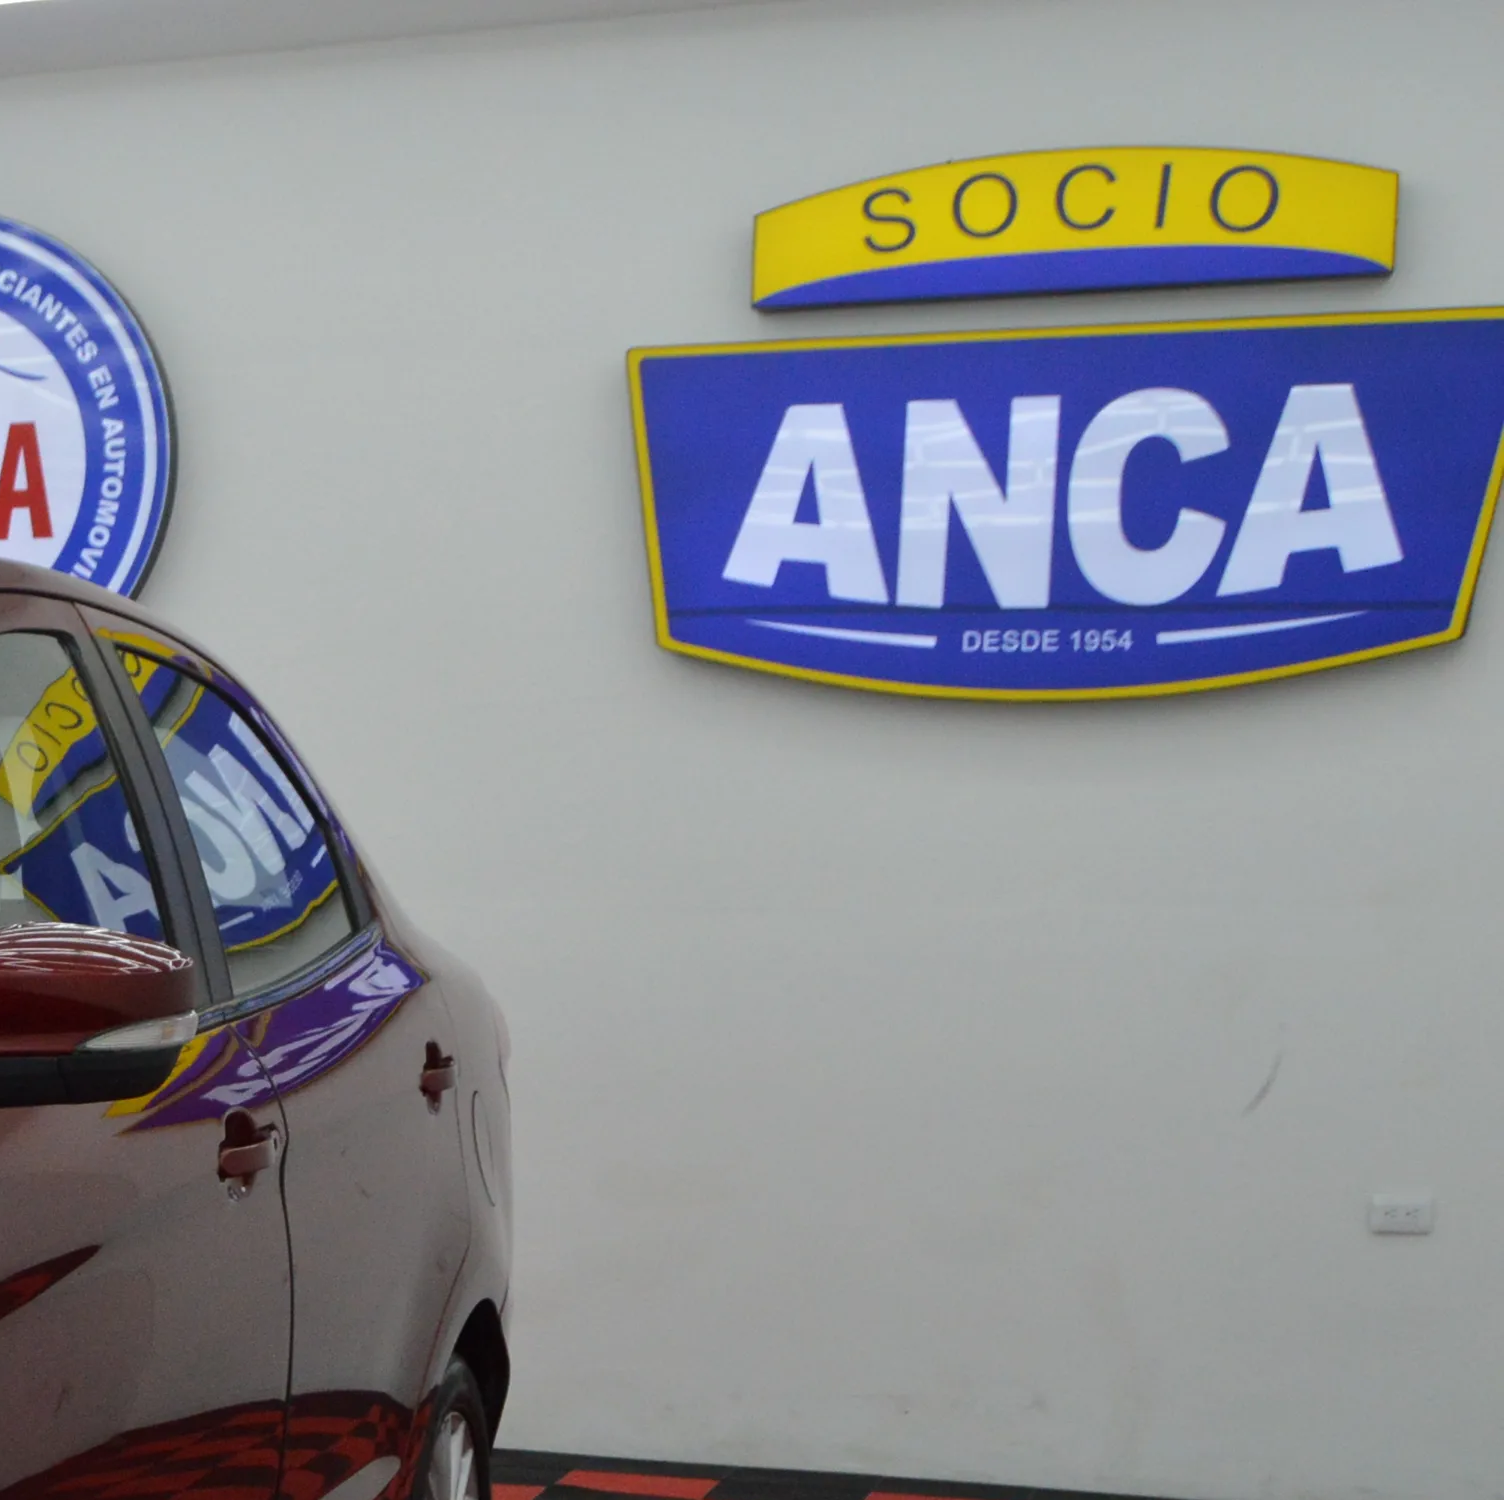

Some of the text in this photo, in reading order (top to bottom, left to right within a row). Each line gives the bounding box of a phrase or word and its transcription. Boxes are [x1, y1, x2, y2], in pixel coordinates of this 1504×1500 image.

[861, 162, 1280, 254] SOCIO
[89, 363, 120, 410] EN
[70, 417, 127, 580] AUTOMOVI
[721, 381, 1404, 610] ANCA
[960, 625, 1134, 655] DESDE 1954
